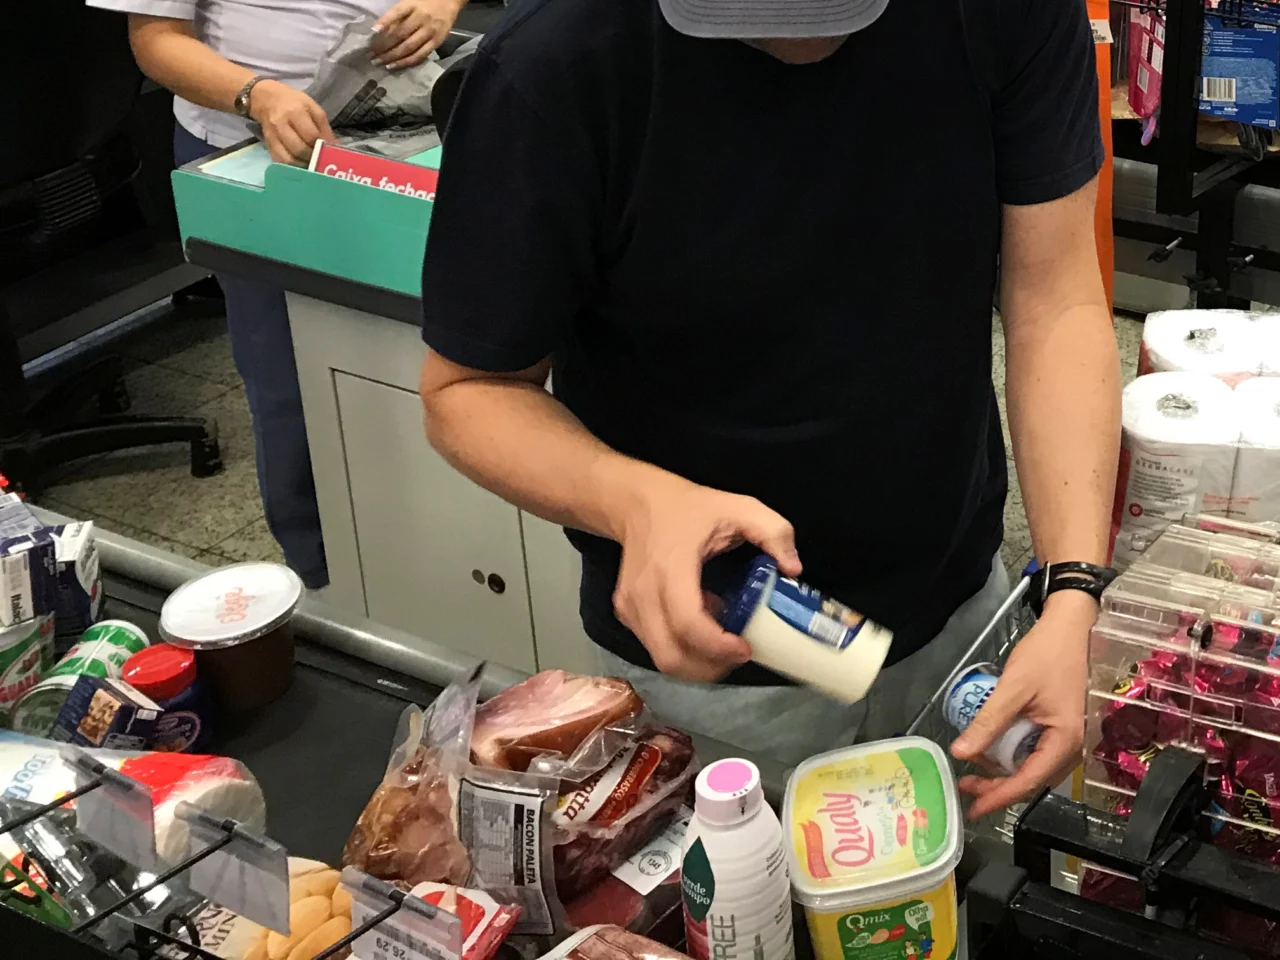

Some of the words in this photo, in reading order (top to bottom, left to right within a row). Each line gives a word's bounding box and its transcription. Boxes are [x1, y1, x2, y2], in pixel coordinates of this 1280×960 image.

[323, 164, 373, 187] Caixa
[525, 808, 536, 844] BACON
[816, 792, 876, 867] Qualy
[525, 844, 537, 885] PALETA
[846, 912, 892, 930] Qmix
